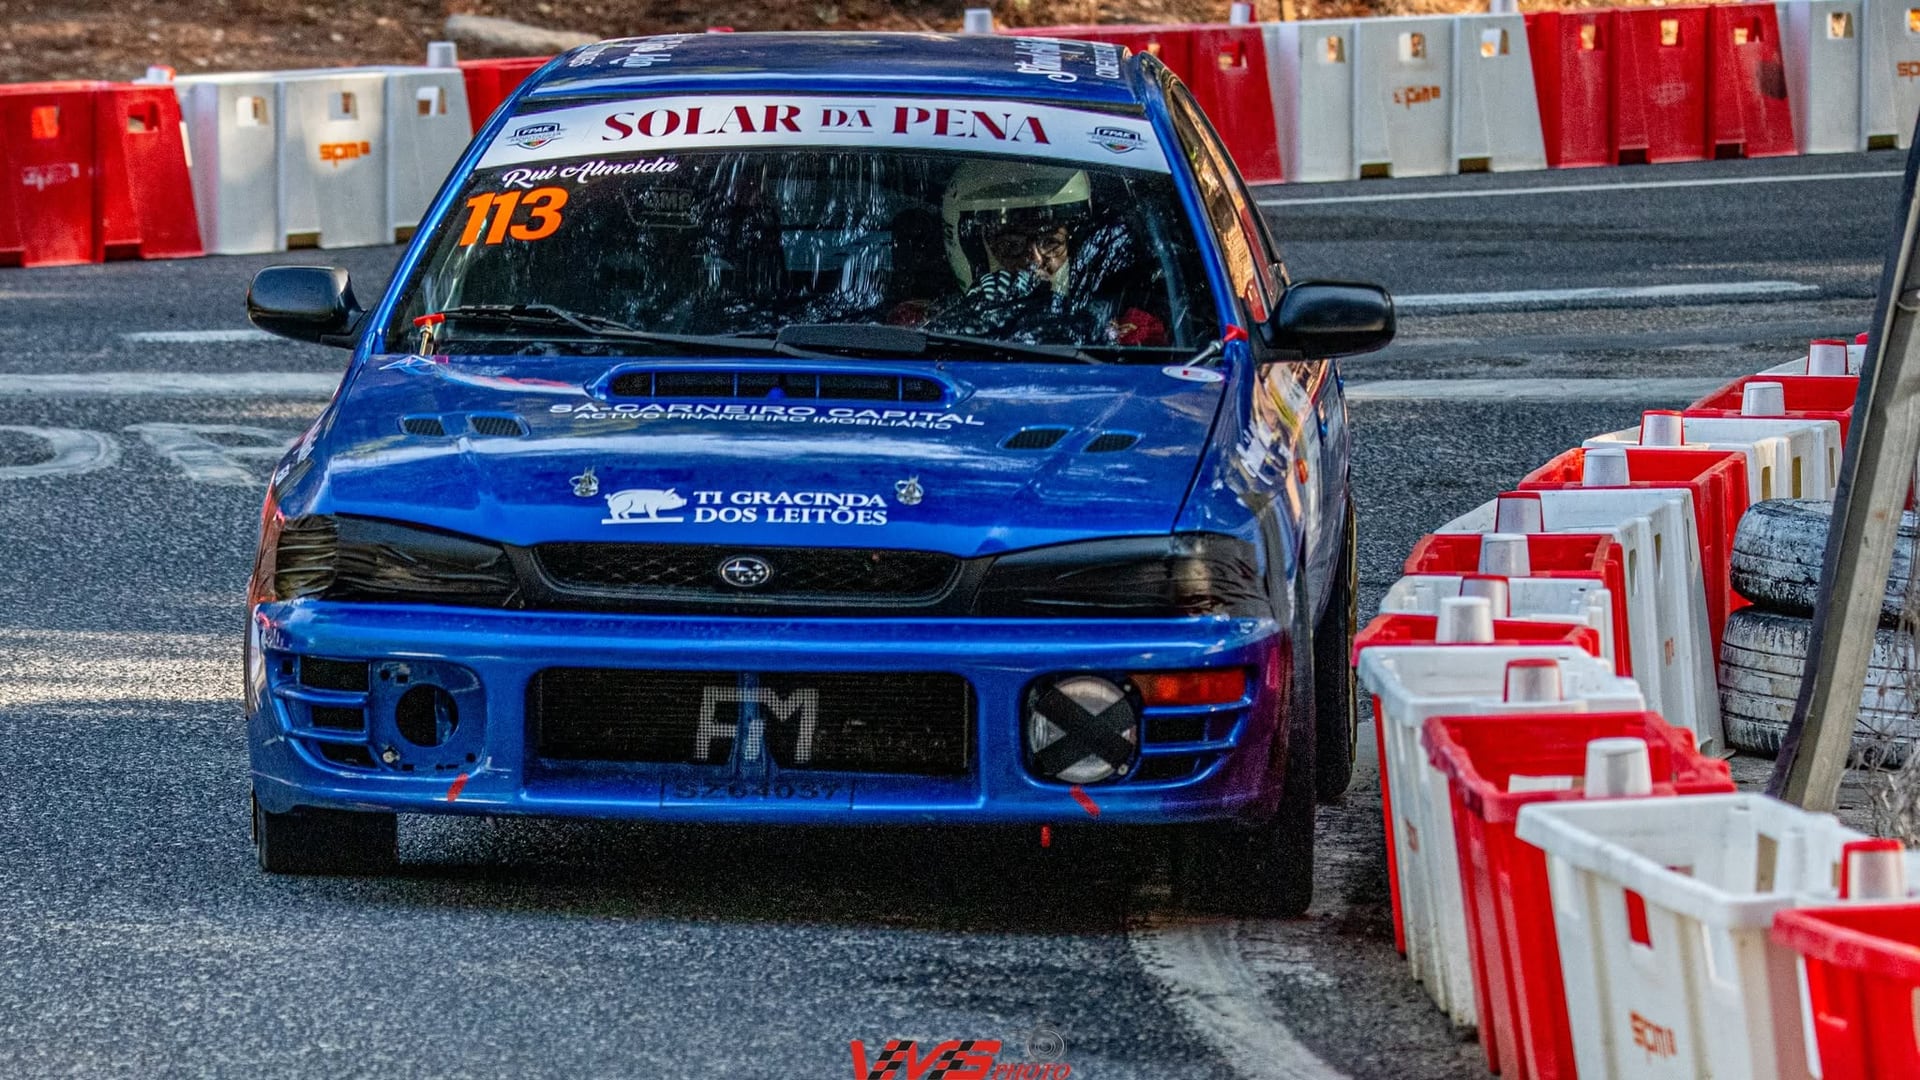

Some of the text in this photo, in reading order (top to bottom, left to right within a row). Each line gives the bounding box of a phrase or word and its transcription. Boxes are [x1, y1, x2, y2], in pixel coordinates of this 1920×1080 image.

[602, 104, 1051, 145] SOLAR DA PENA
[502, 156, 679, 188] Rui Almeida
[459, 186, 568, 247] 113
[575, 412, 660, 420] ACTIVO
[667, 412, 806, 422] FINANCEIRO
[828, 408, 985, 426] CAPITAL
[693, 491, 888, 507] TI GRACINDA
[694, 506, 888, 526] DOS LEITÕES
